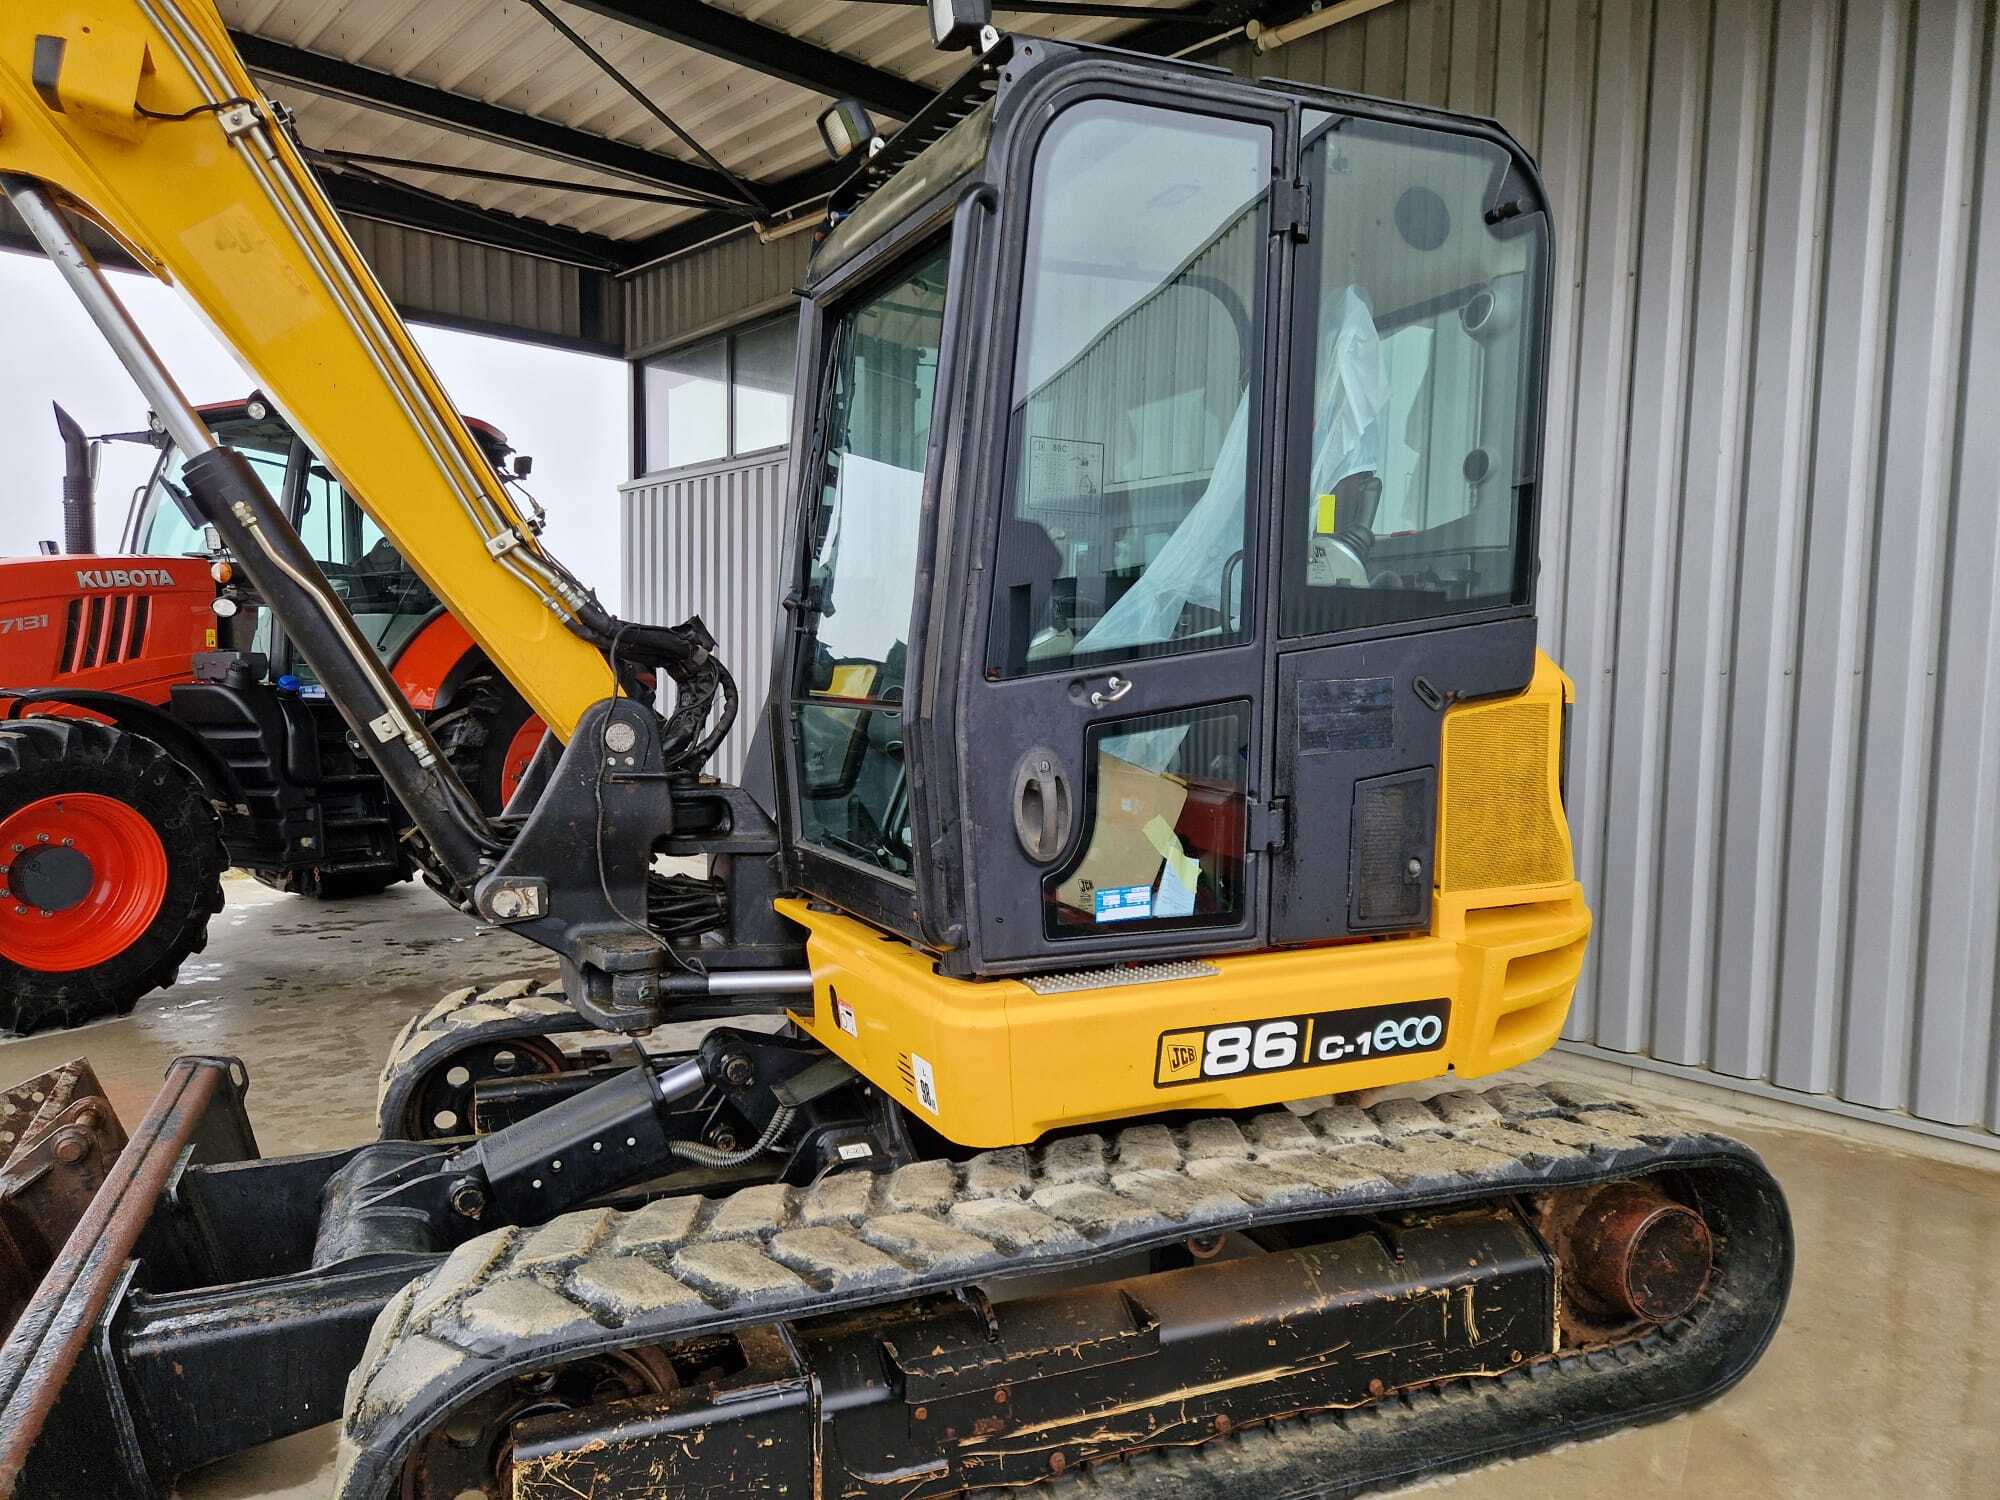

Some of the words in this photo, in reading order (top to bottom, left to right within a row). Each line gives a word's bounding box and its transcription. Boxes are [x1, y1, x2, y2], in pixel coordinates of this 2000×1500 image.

[76, 569, 176, 588] KUBOTA
[0, 614, 49, 634] 7131
[1171, 1047, 1196, 1069] JCB
[1203, 1021, 1298, 1076] 86
